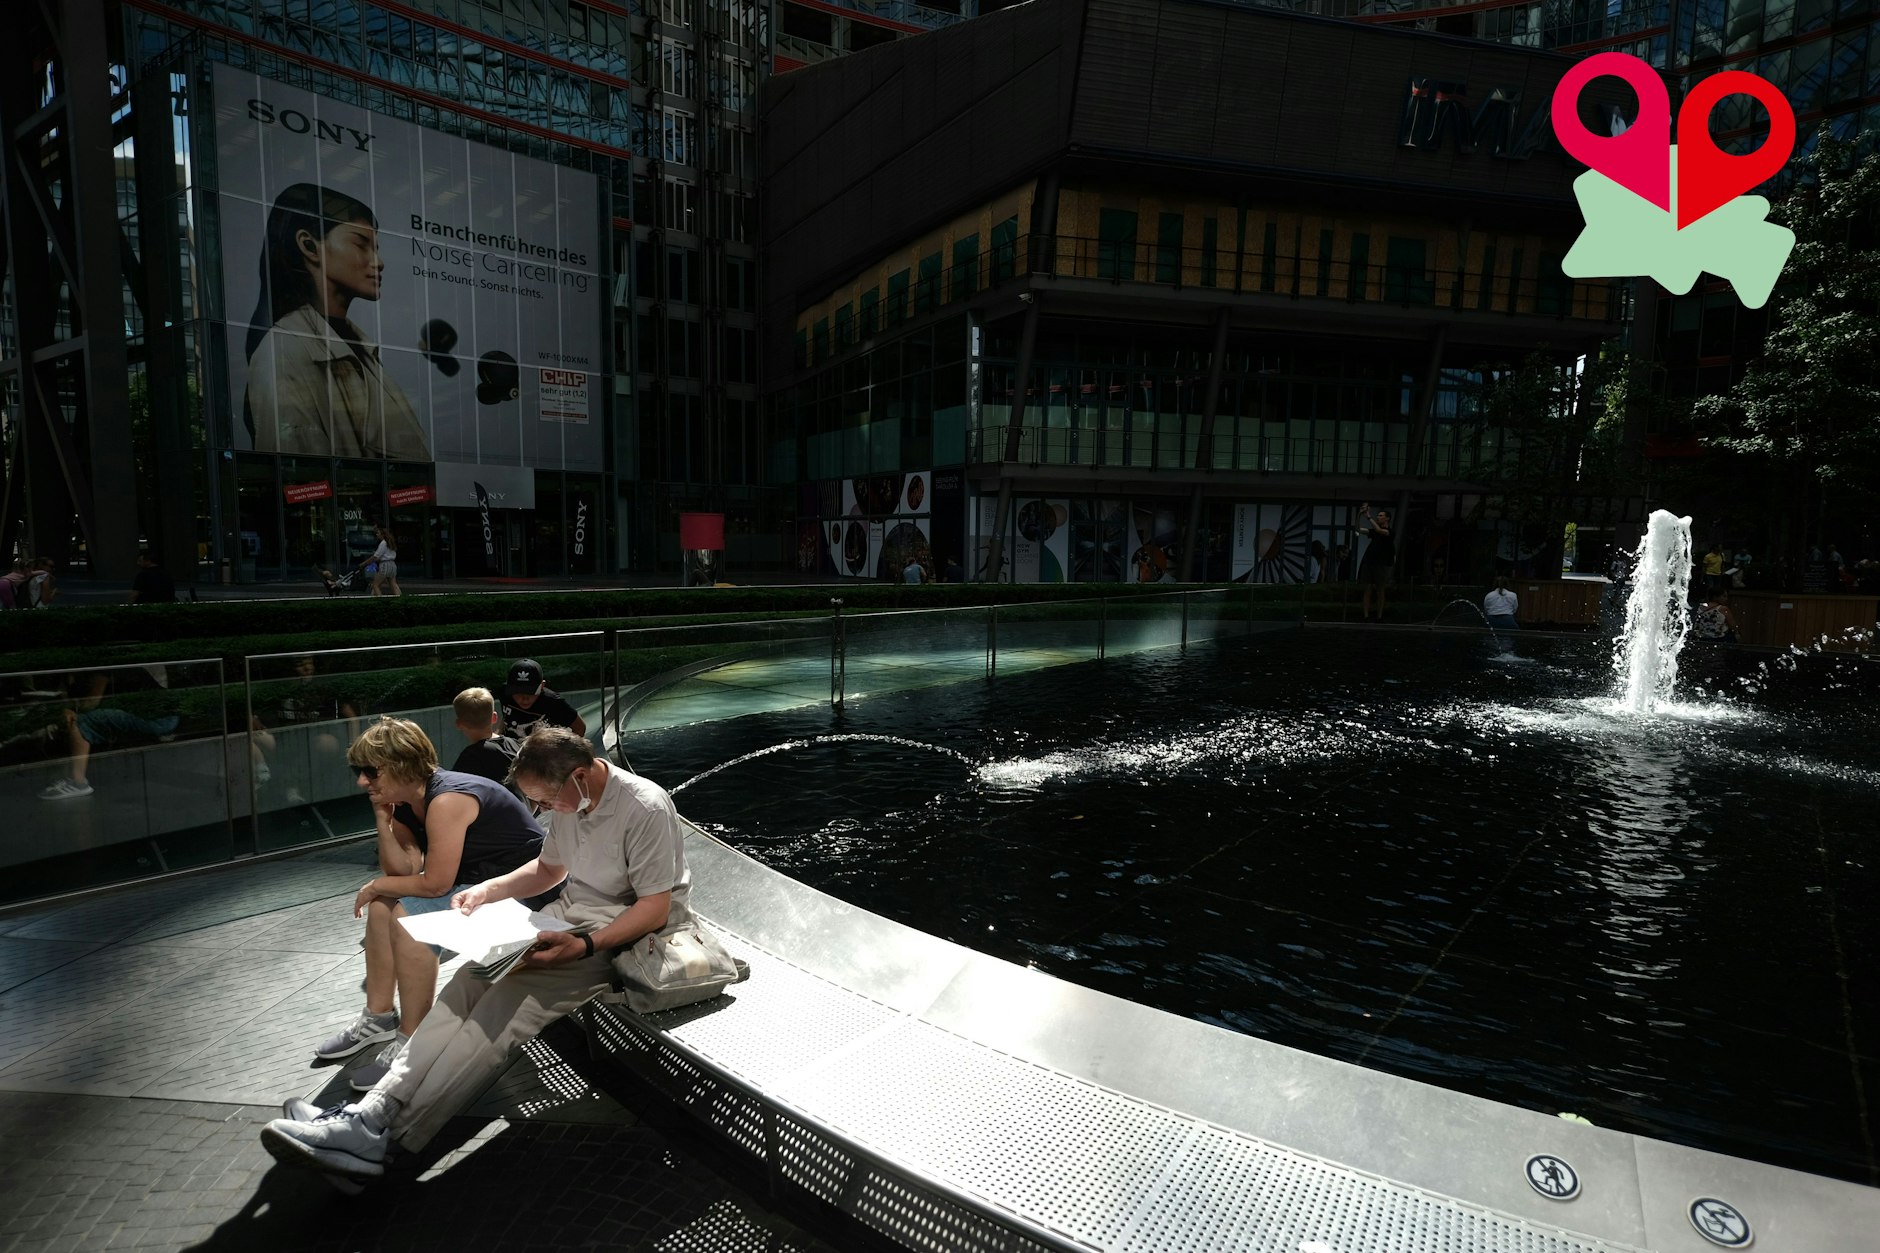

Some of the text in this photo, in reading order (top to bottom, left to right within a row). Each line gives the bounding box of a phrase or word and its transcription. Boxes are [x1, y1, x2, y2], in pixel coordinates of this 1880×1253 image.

[247, 98, 376, 153] SONY
[410, 213, 588, 266] Branchenführendes
[411, 237, 474, 269] Noise
[412, 265, 544, 299] Dein Sound. Sonst nichts.
[540, 387, 557, 395] sehr
[541, 369, 586, 387] CHIP
[468, 491, 506, 500] SNY
[343, 509, 363, 520] SONY
[574, 499, 588, 555] SONY
